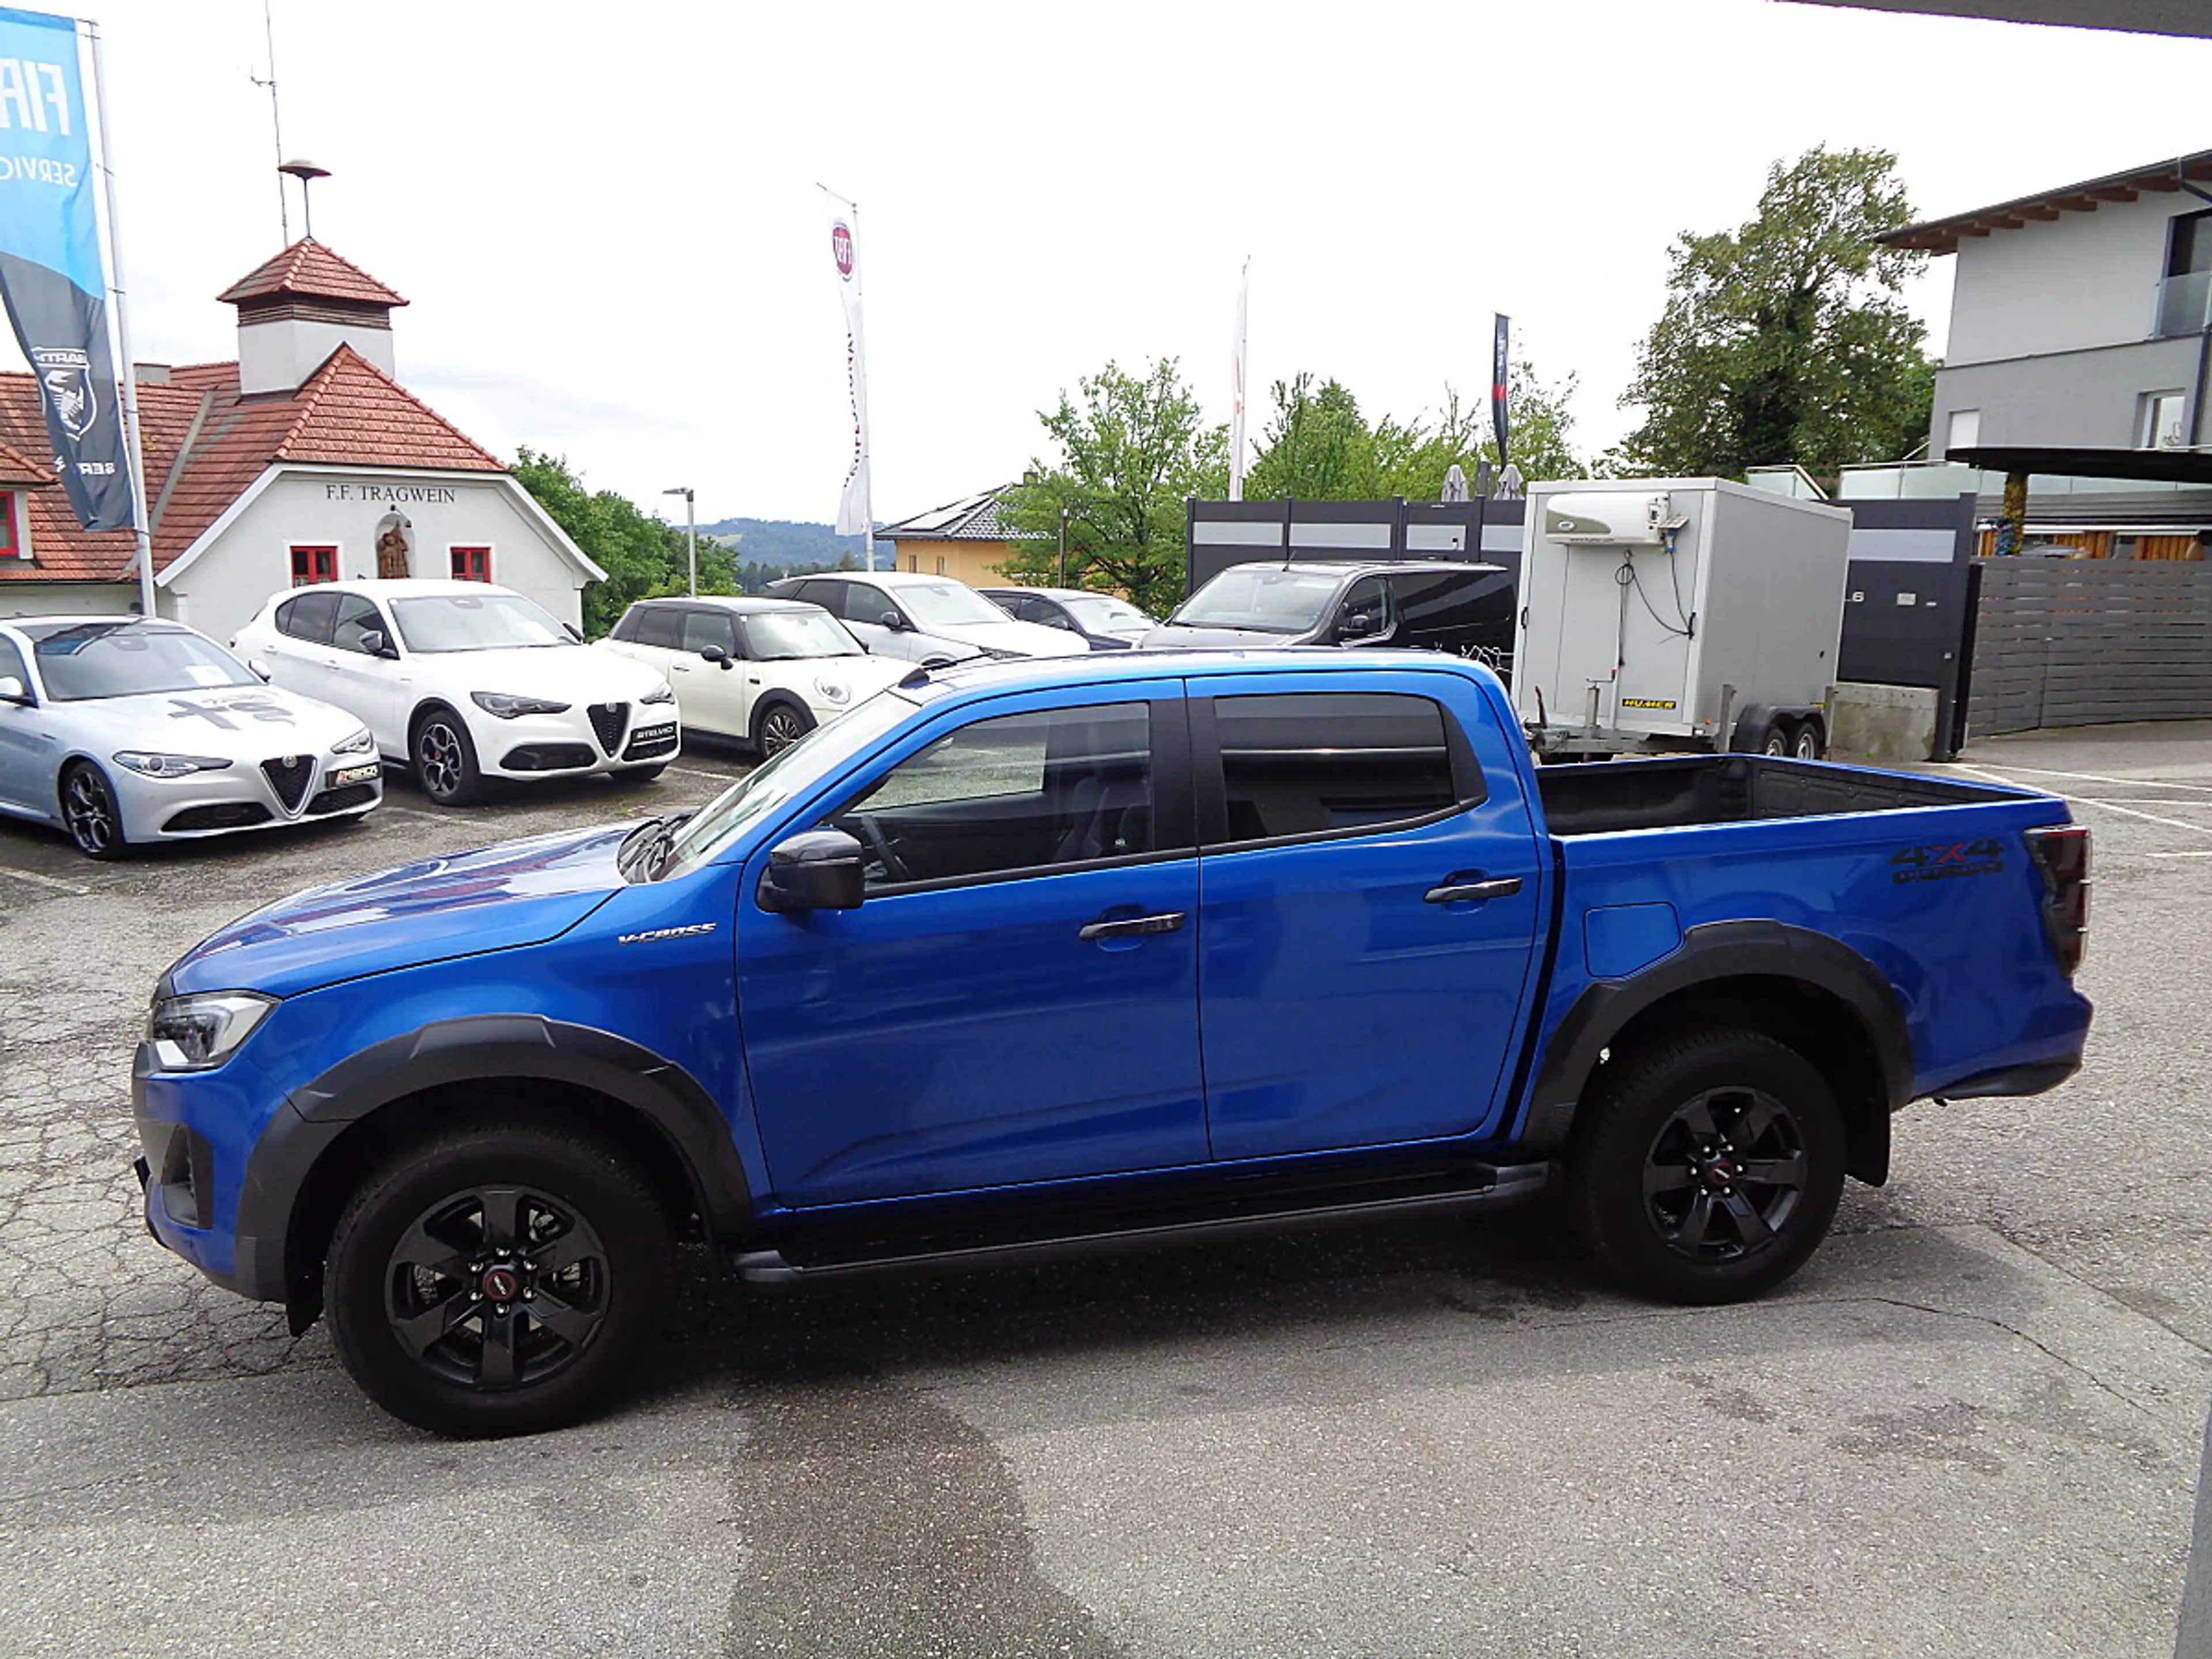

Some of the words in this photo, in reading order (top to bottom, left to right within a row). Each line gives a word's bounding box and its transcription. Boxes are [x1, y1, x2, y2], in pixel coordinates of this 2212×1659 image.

[325, 484, 353, 501] F.F.
[358, 486, 455, 503] TRAGWEIN
[618, 922, 717, 945] V-CROSS
